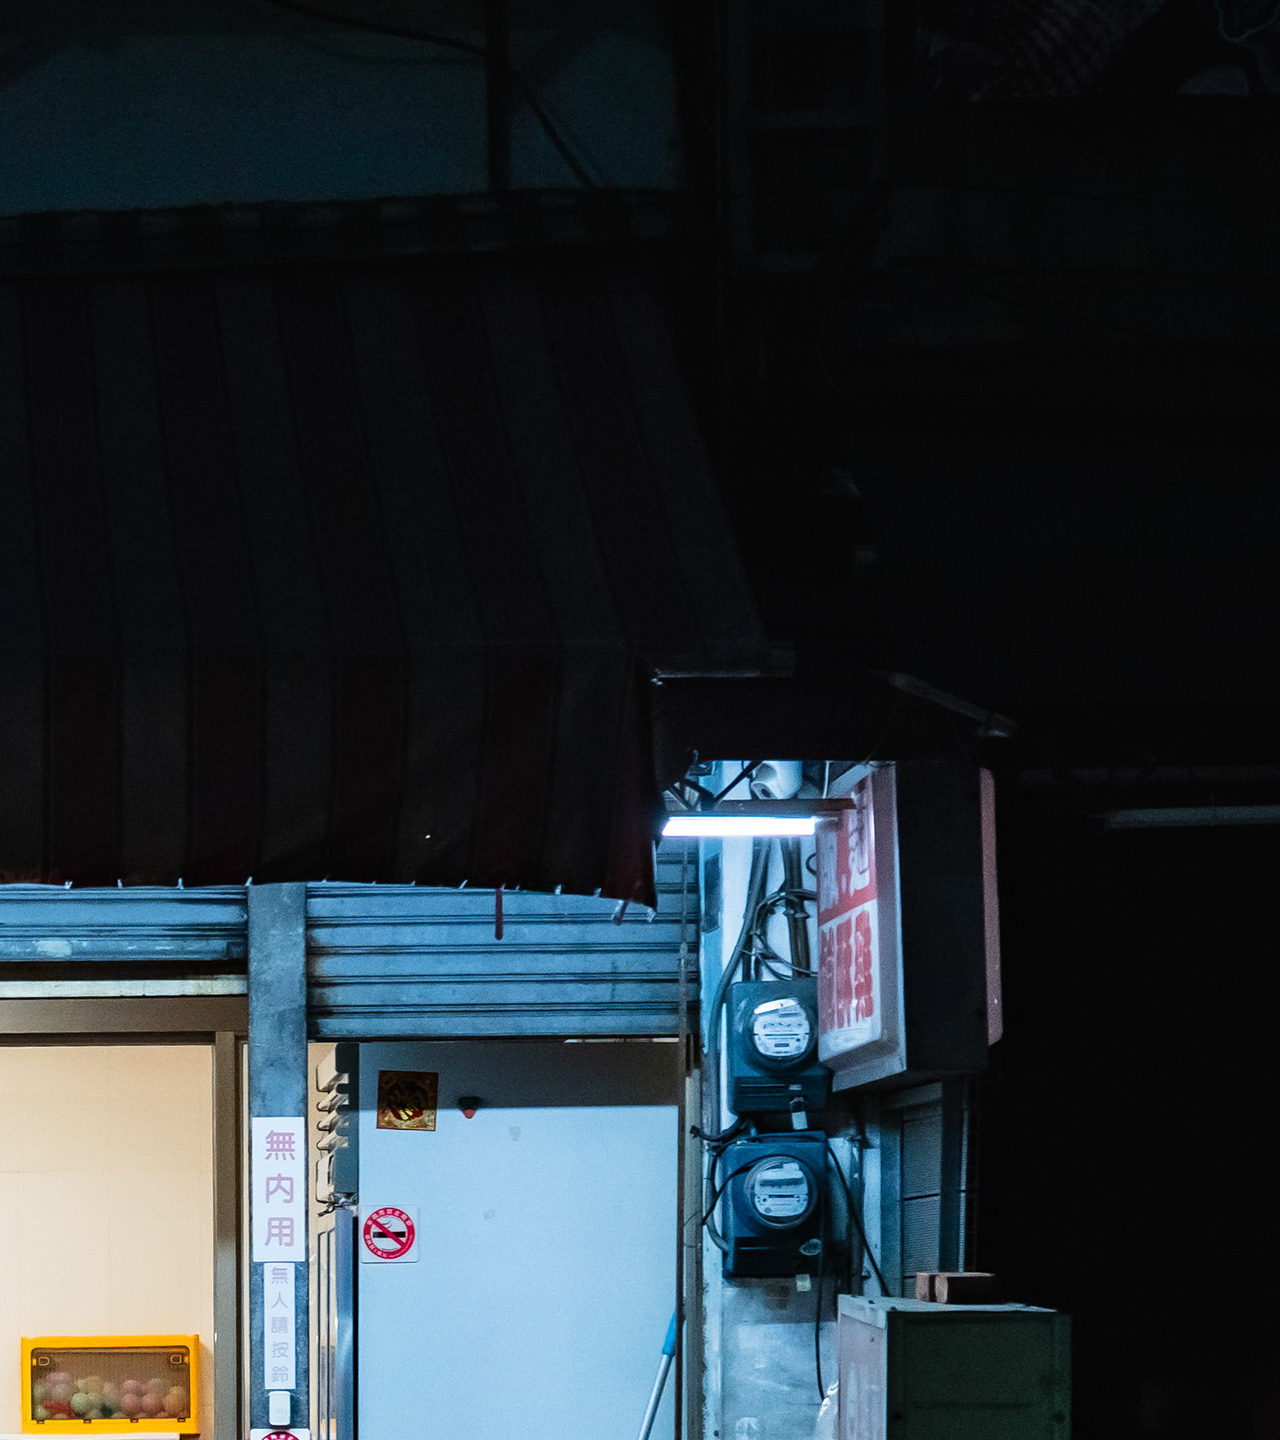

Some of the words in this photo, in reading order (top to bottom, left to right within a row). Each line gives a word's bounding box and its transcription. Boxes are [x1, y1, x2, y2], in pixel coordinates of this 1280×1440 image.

[264, 1130, 295, 1247] 無內用
[271, 1266, 289, 1383] 無人請按鈴
